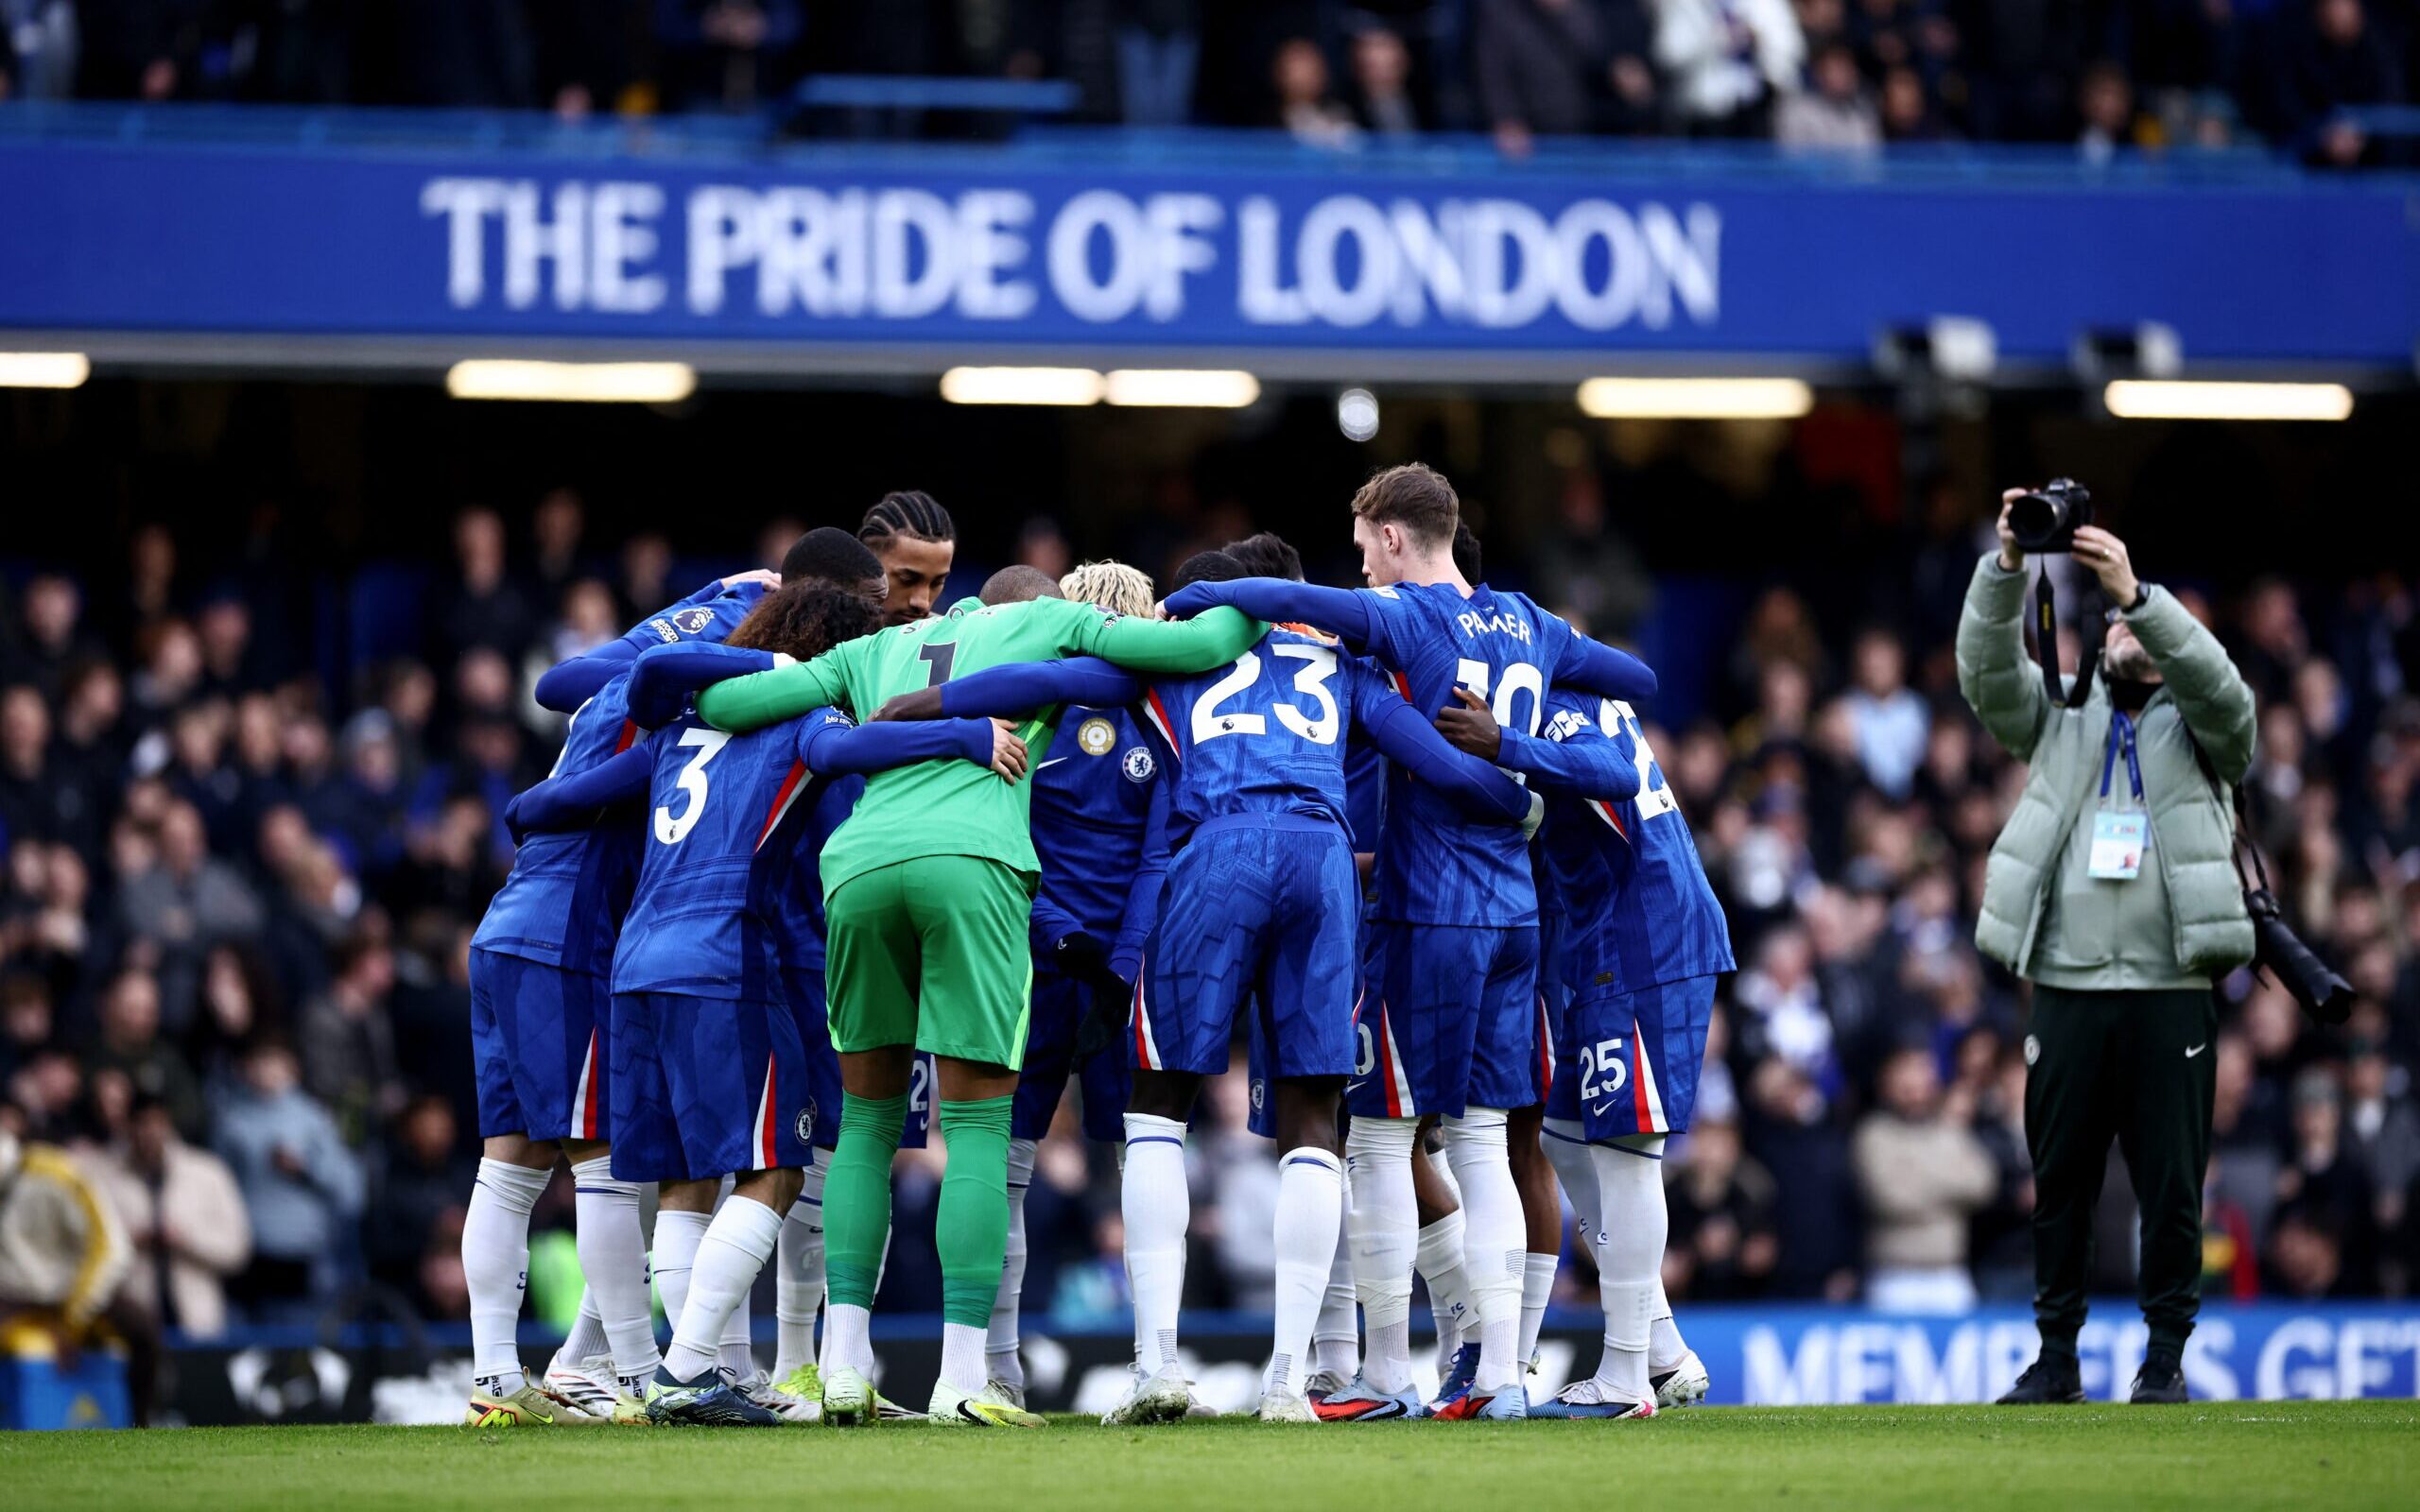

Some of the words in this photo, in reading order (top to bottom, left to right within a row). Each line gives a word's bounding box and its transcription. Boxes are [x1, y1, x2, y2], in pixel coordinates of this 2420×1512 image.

[421, 178, 665, 313] THE
[687, 185, 1038, 318] PRIDE
[1046, 189, 1223, 323] OF
[1237, 195, 1720, 331] LONDON
[1458, 610, 1531, 645] PAMER
[918, 641, 958, 688] 1
[1191, 644, 1339, 746] 23
[654, 727, 734, 845] 3
[910, 1059, 928, 1112] 2
[1580, 1038, 1626, 1100] 25
